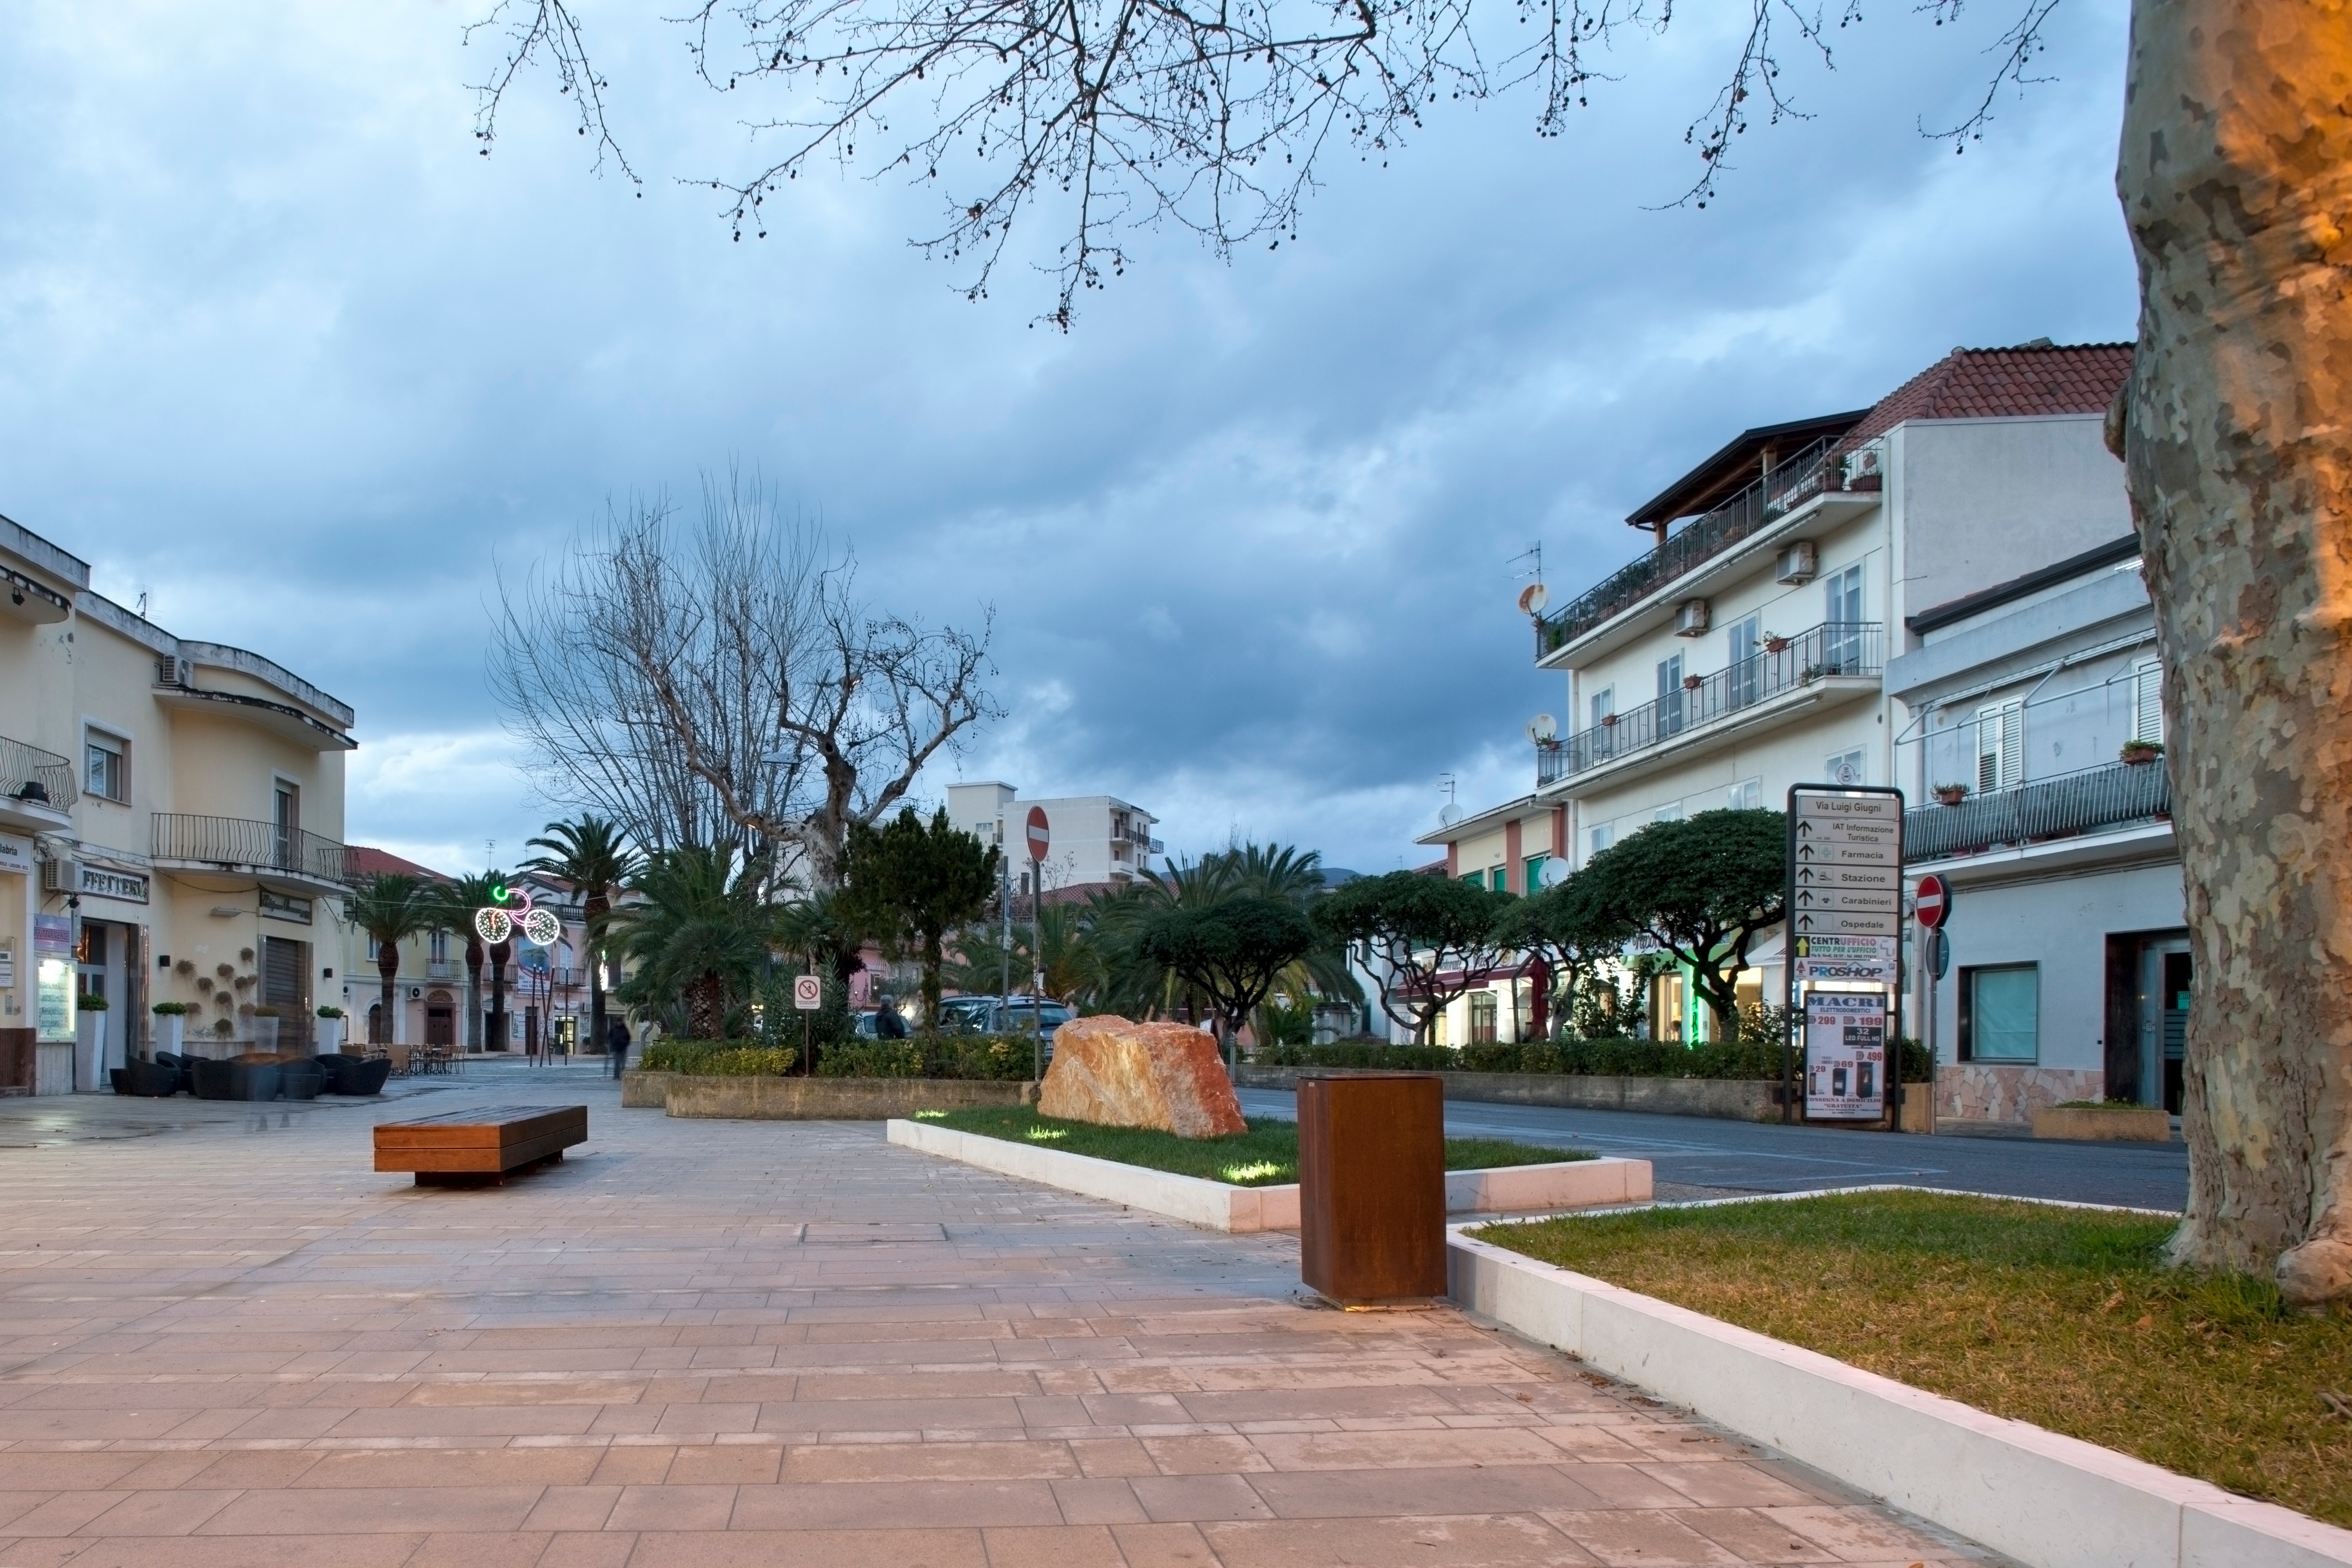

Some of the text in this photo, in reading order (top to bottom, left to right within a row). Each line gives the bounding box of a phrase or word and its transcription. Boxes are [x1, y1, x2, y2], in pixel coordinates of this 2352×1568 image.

[1816, 801, 1881, 813] Via Luigi Giugni
[1846, 824, 1894, 834] Informazione
[1847, 834, 1878, 842] Turistica
[0, 843, 17, 856] labria
[1841, 850, 1883, 859] Farmacia
[1841, 874, 1885, 883] Stazione
[1841, 897, 1891, 905] Carabinieri
[1841, 920, 1884, 929] Ospedale
[1811, 936, 1877, 946] CENTRUFFICIO
[1809, 966, 1883, 977] PROSHOP
[1818, 1016, 1835, 1025] 299
[1859, 1017, 1882, 1026] 199
[1867, 1052, 1882, 1061] 499
